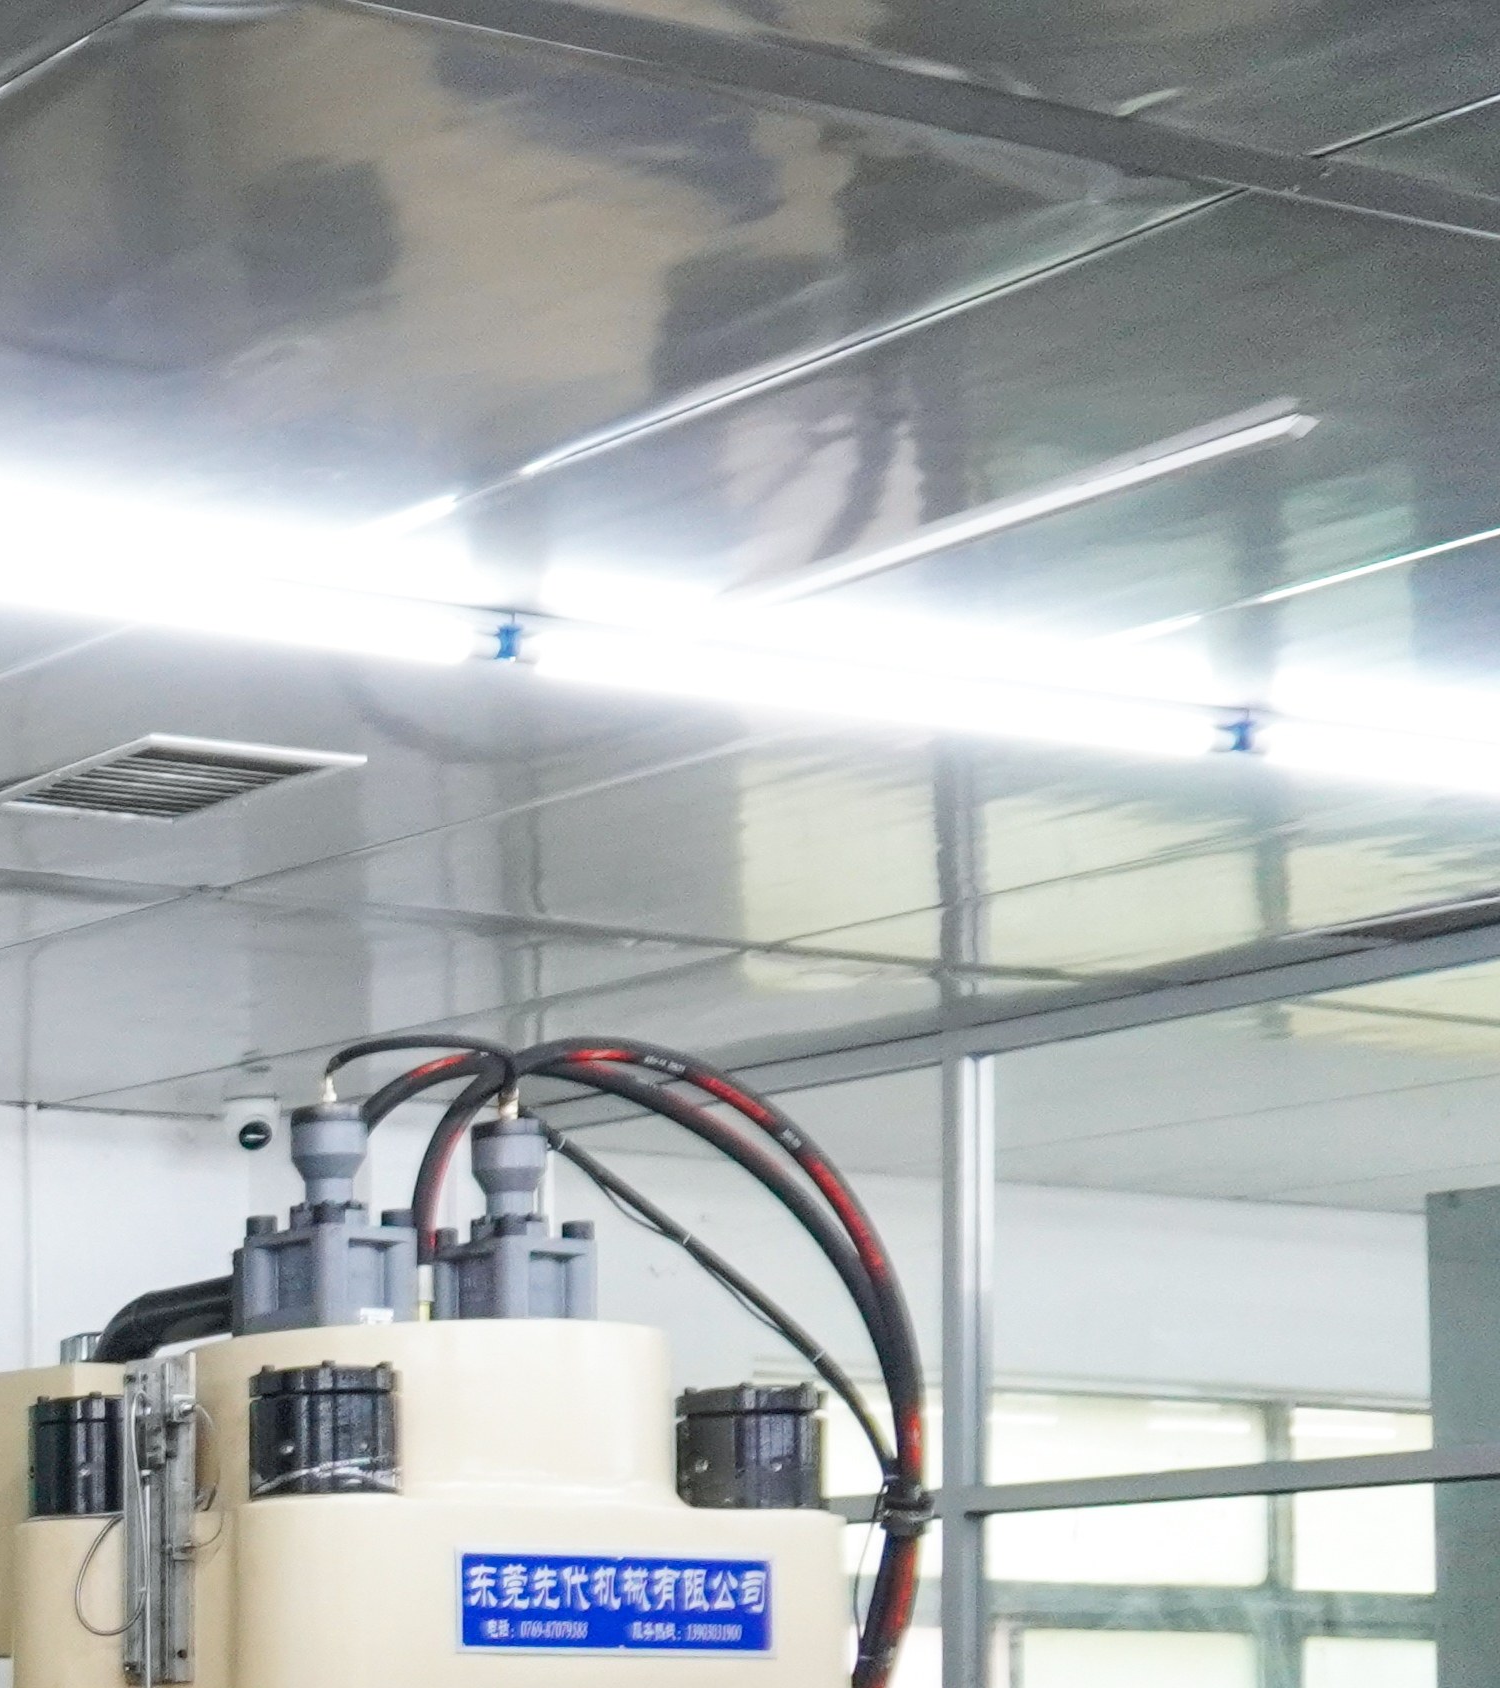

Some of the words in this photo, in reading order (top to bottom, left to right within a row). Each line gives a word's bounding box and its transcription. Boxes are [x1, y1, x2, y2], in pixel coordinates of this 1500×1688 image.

[468, 1563, 768, 1614] 东莞先代机械有限公司
